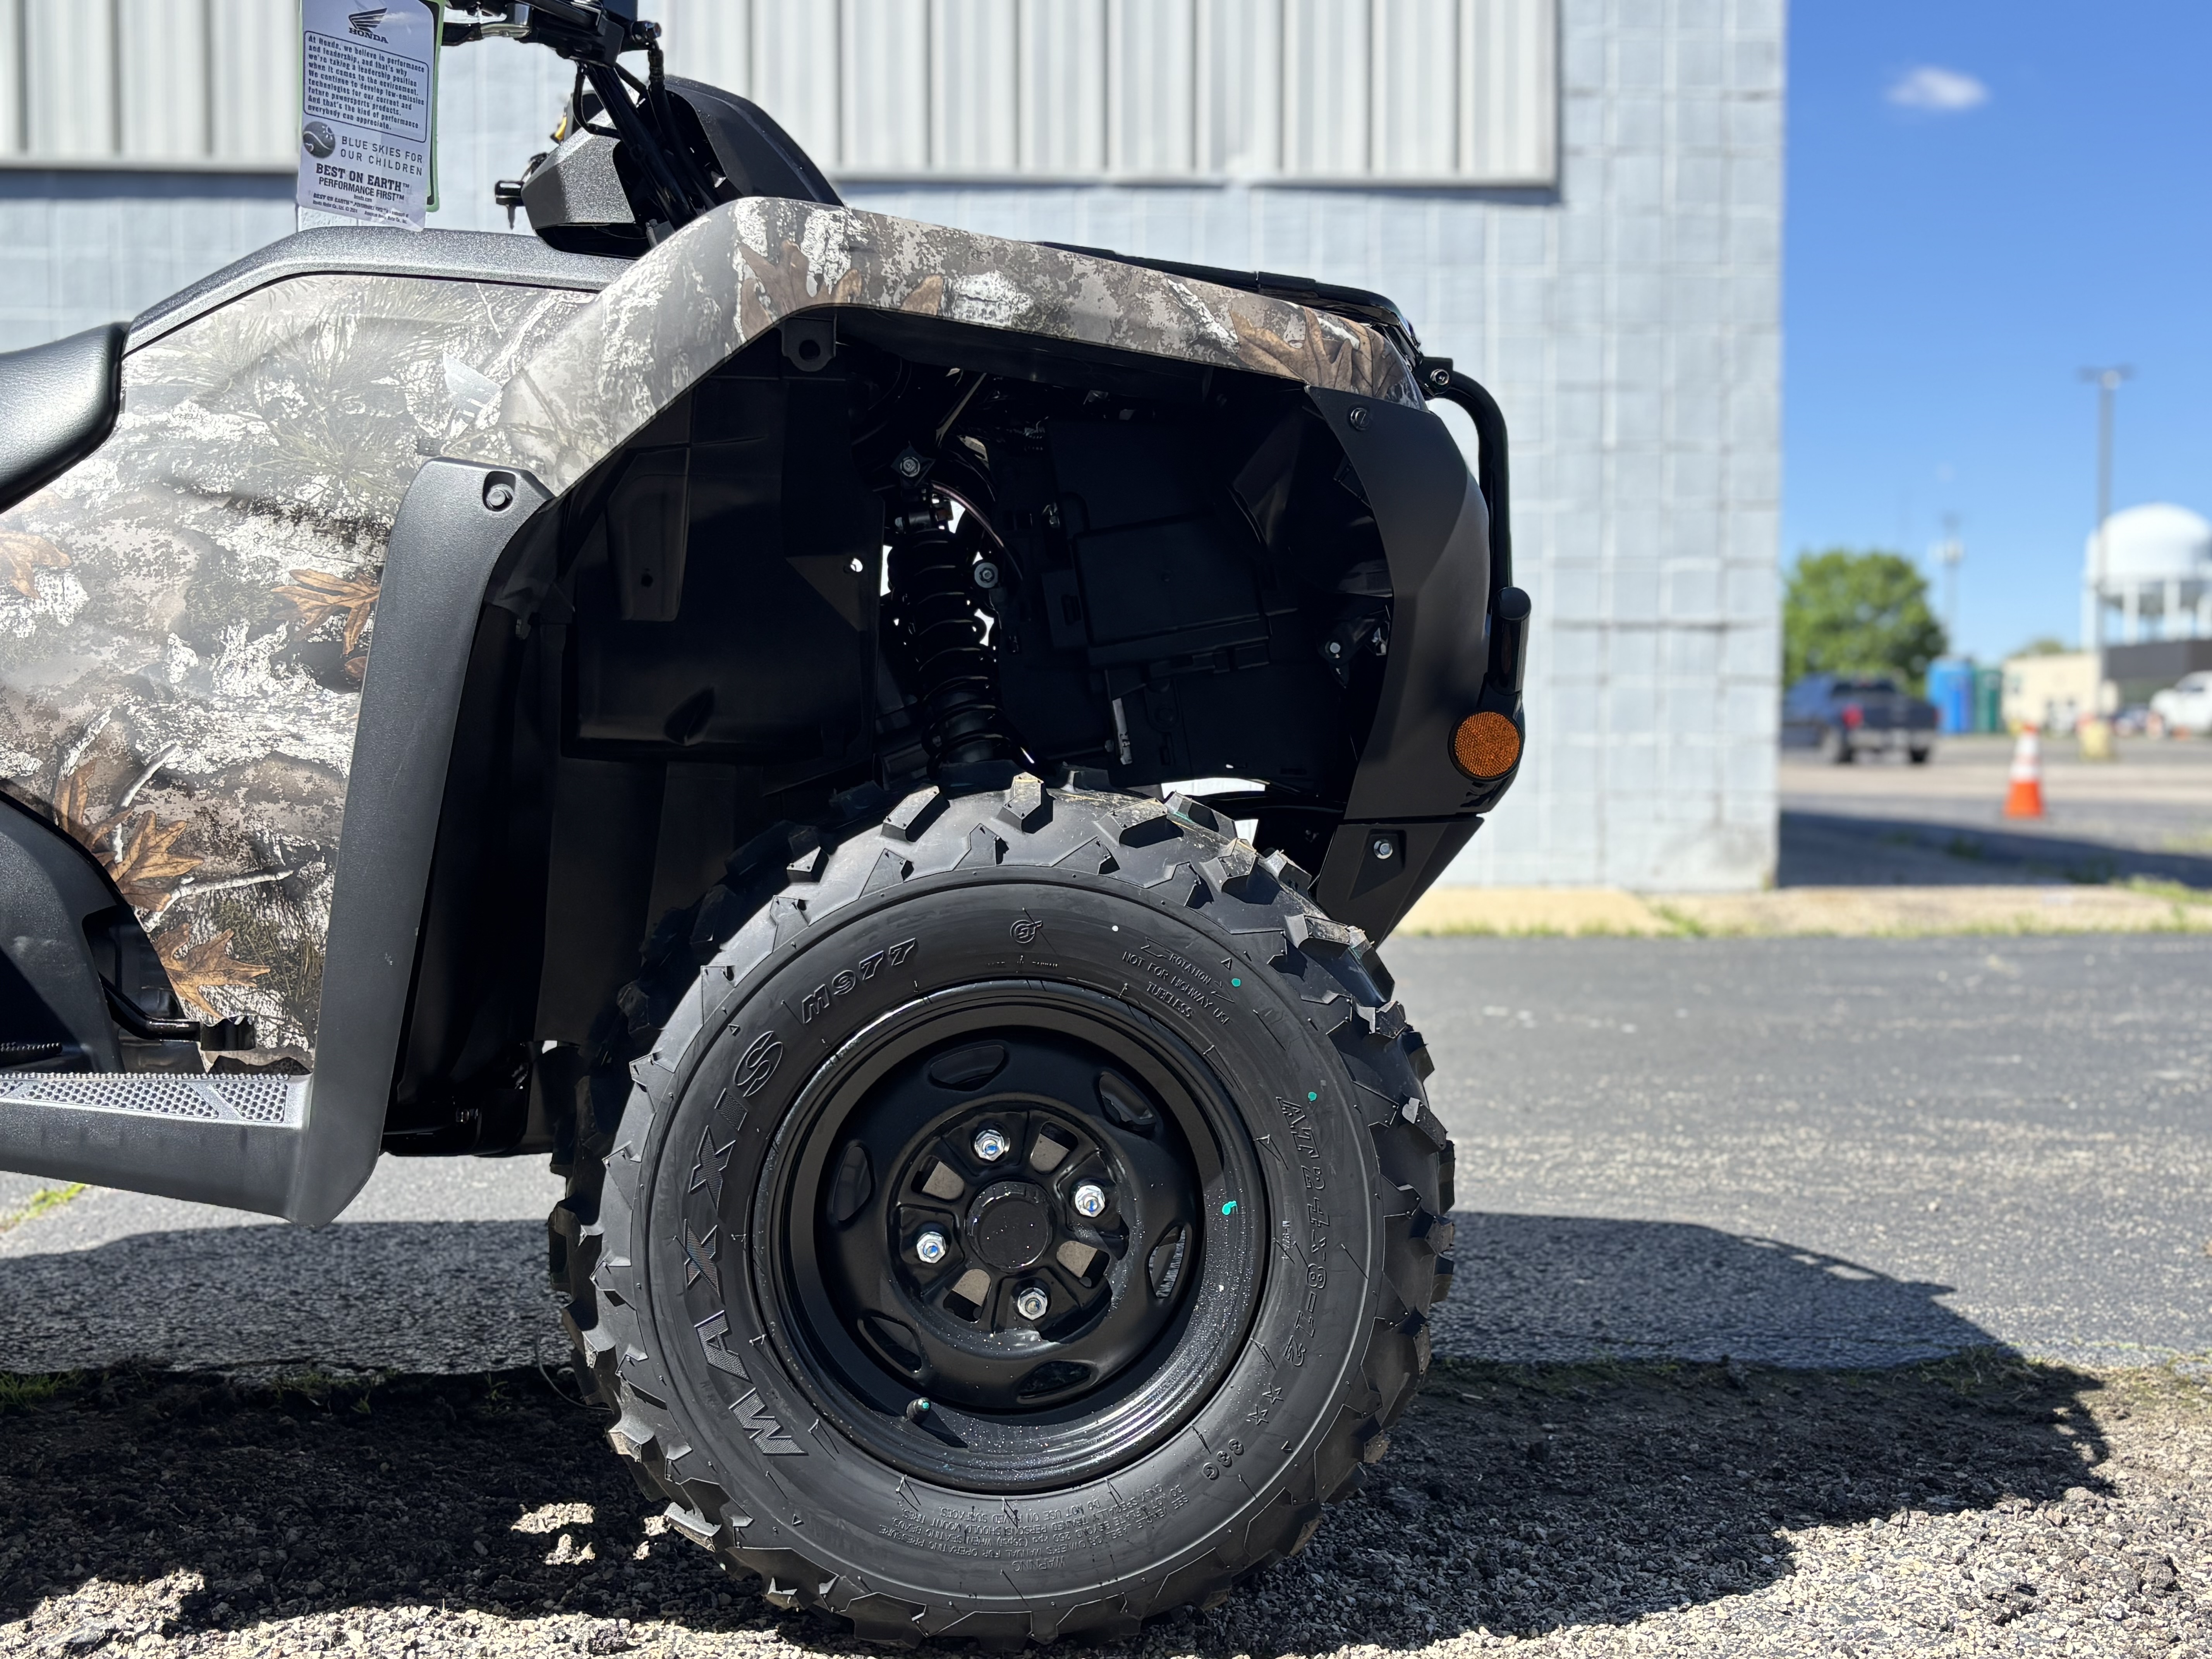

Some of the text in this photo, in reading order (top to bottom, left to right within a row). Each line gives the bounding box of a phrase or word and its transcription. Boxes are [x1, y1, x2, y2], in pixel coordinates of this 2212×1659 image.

[349, 27, 388, 44] HONDA
[308, 34, 316, 43] At
[319, 37, 341, 50] Honda,
[355, 46, 376, 59] believe
[379, 53, 385, 62] in
[387, 56, 424, 73] performance
[309, 43, 407, 77] and leadership, and that's why
[309, 52, 326, 63] we're
[330, 57, 350, 70] taking
[359, 65, 390, 81] leadership
[393, 74, 417, 88] position
[309, 60, 325, 71] when
[328, 65, 333, 73] it
[336, 68, 356, 79] comes
[368, 76, 377, 84] the
[380, 79, 418, 96] environment.
[309, 69, 424, 105] We continue to develop low-emission
[309, 77, 412, 110] technologies for our current and
[309, 86, 401, 117] future powersports products.
[308, 94, 418, 129] And that's the kind of performance
[308, 103, 391, 131] everybody can appreciate.
[342, 136, 422, 163] BLUE SKIES FOR
[341, 149, 422, 176] OUR CHILDREN
[316, 163, 345, 179] BEST
[349, 170, 363, 183] ON
[319, 177, 374, 196] PERFORMANCE
[1169, 953, 1212, 985] ROTATION
[802, 937, 917, 1024] M977
[1122, 951, 1145, 967] NOT
[1147, 962, 1169, 980] FOR
[1170, 975, 1213, 1008] HIGHWAY
[1146, 981, 1195, 1018] TUBELESS
[684, 1030, 809, 1456] MAXXIS
[1142, 1484, 1163, 1501] ONLY
[1170, 1484, 1183, 1497] DO
[1066, 1503, 1084, 1517] NOT
[1087, 1498, 1101, 1510] DO
[1171, 1494, 1189, 1510] SEE
[1027, 1512, 1039, 1523] ON
[1043, 1509, 1062, 1520] USE
[1052, 1515, 1089, 1531] TRAINED
[930, 1518, 962, 1532] MOUNT
[965, 1525, 1001, 1536] SHOULD
[1005, 1524, 1047, 1535] PERSONS
[925, 1528, 963, 1544] SEATING
[965, 1536, 992, 1547] WHEN
[928, 1541, 978, 1557] OPERATING
[982, 1549, 1001, 1558] FOR
[1005, 1548, 1042, 1558] MANUAL
[1012, 1556, 1065, 1572] WARNING
